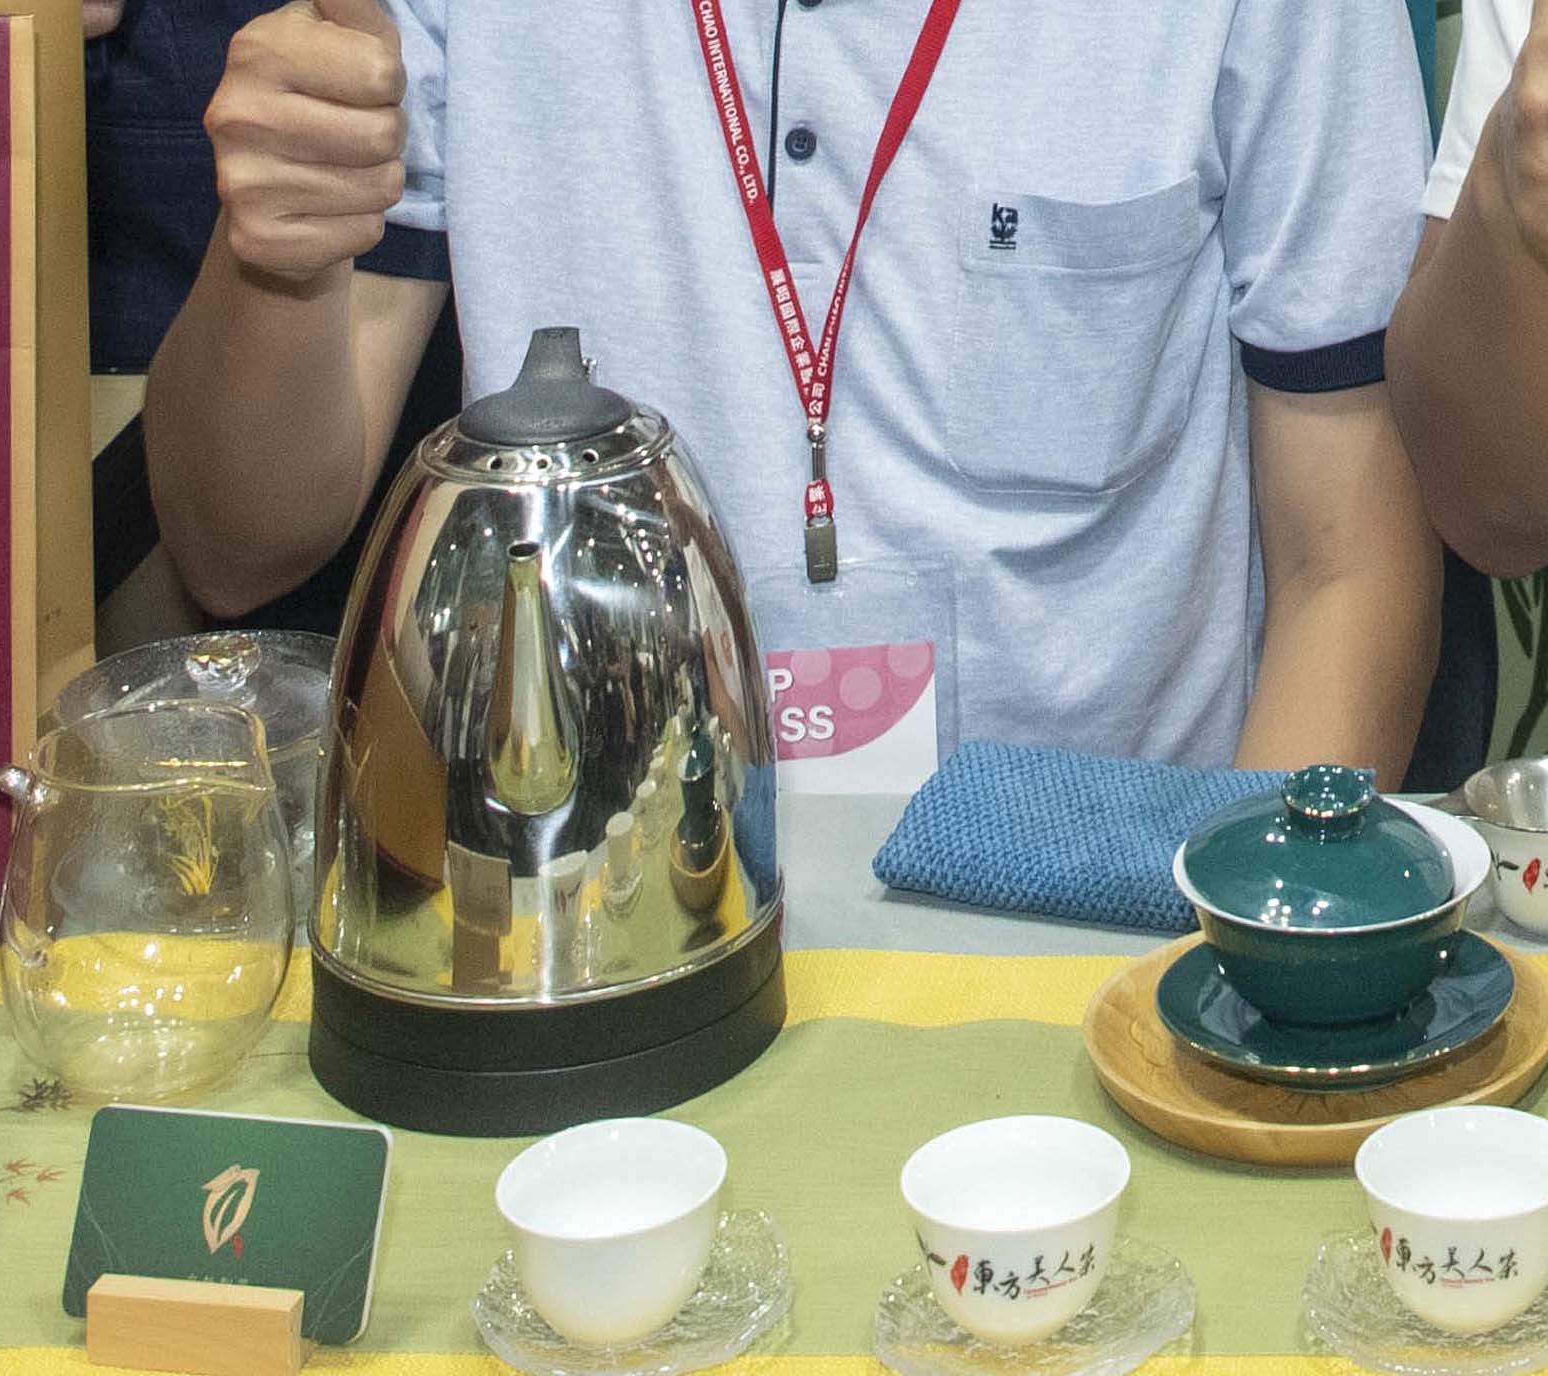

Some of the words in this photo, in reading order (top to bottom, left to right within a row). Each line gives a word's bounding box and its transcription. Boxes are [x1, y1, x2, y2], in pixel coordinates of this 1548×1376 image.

[706, 38, 745, 144] INTERNATIONAL
[741, 173, 761, 204] LTD.
[814, 335, 836, 377] CHAN
